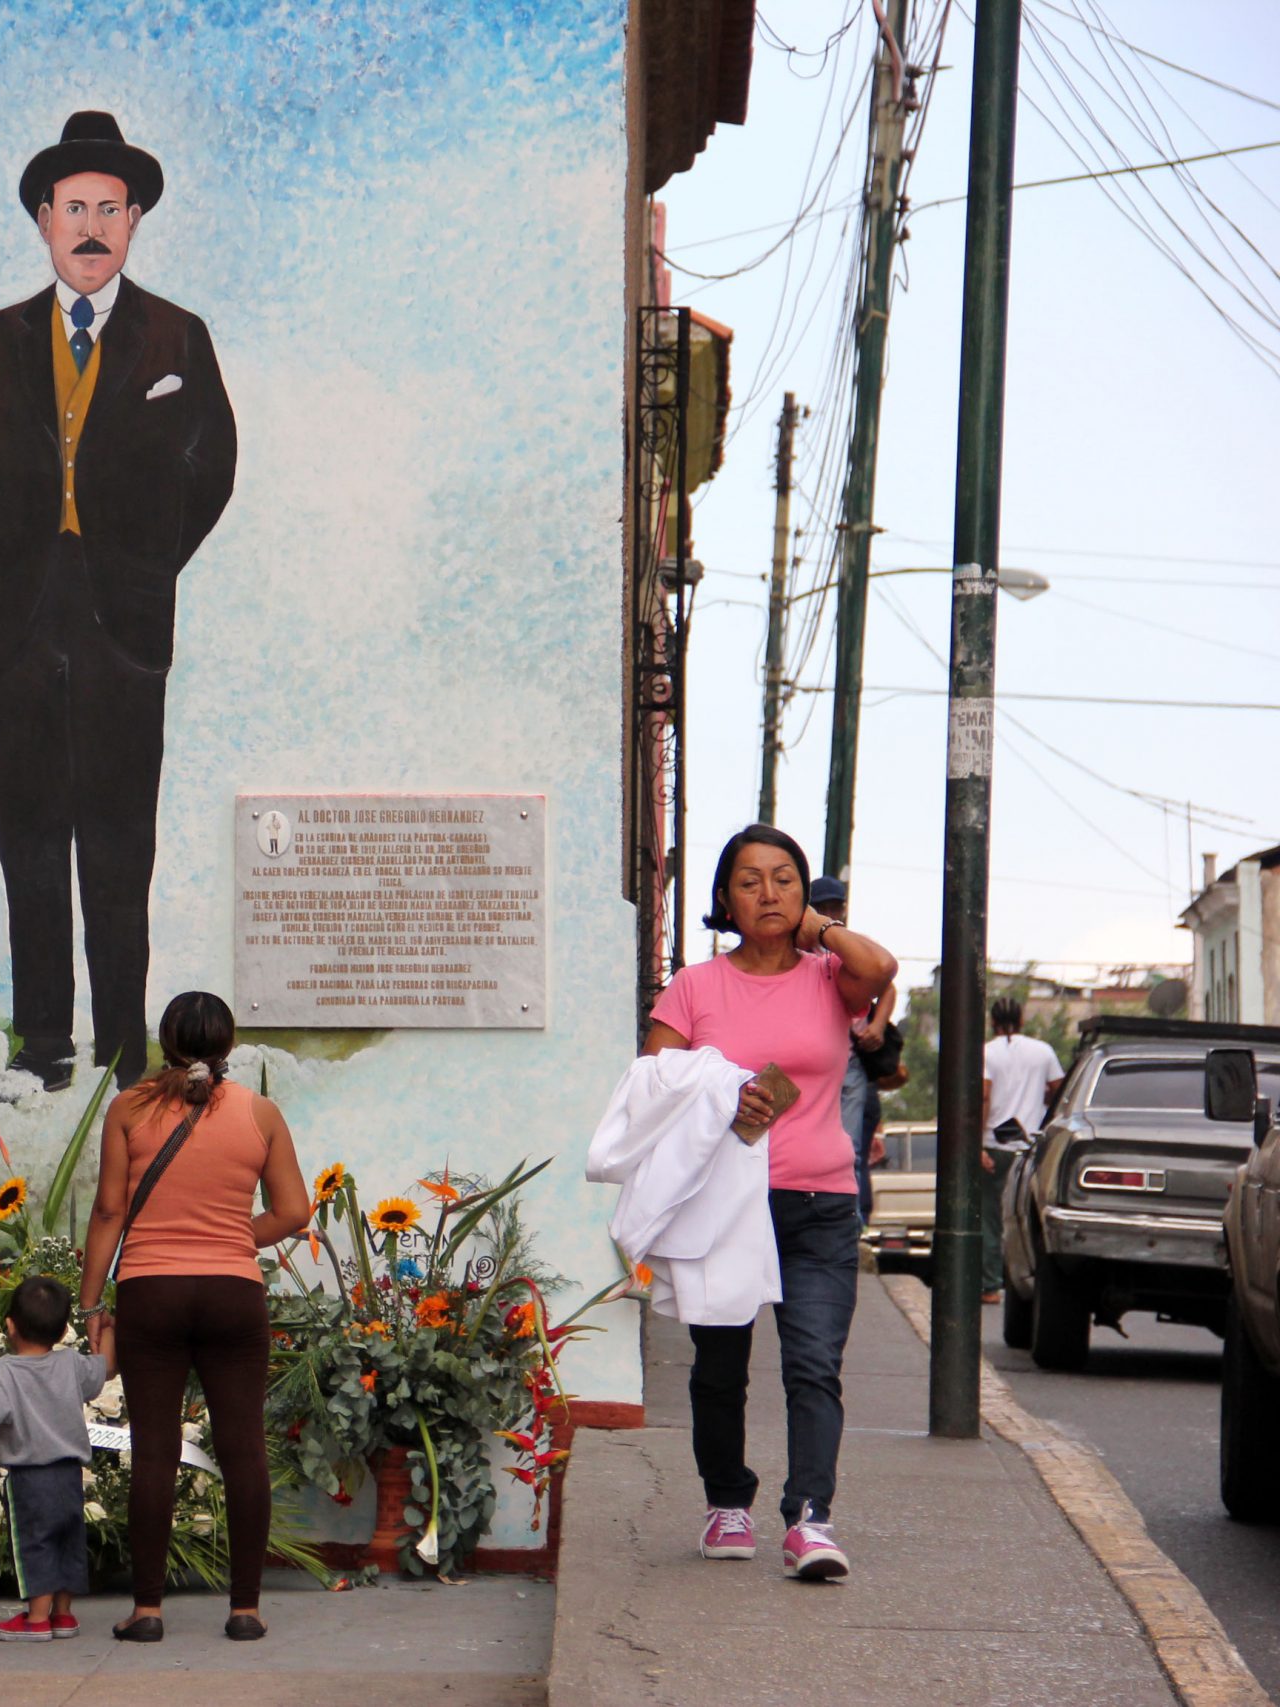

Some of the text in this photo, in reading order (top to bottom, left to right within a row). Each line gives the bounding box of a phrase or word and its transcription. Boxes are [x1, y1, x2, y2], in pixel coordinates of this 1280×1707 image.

[298, 810, 484, 824] AL DOCTOR JOSE GREGORIO HERNANDEZ
